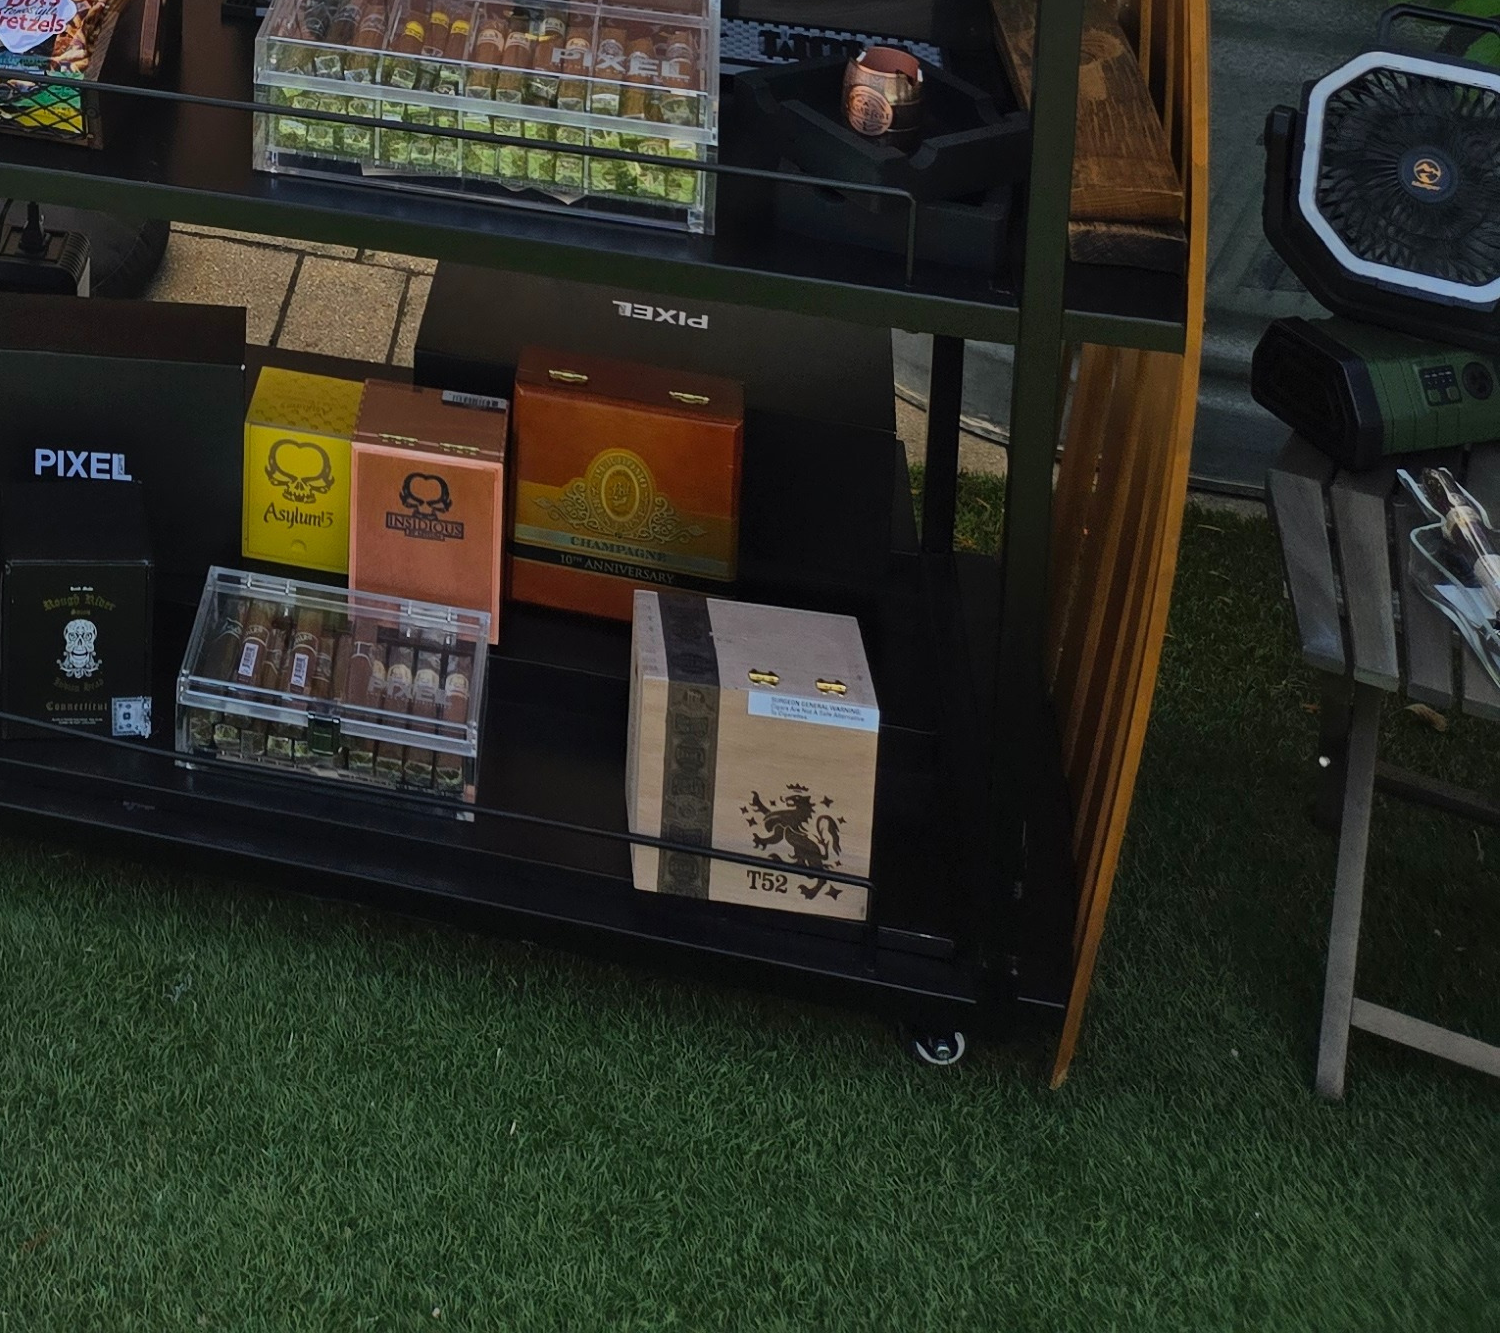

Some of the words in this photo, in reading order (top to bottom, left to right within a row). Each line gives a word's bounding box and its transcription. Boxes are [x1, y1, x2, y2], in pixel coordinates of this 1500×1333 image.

[551, 47, 690, 80] PIXEL
[612, 300, 709, 330] PIXEL
[35, 448, 133, 481] PIXEL
[389, 513, 464, 539] INSIDIOUS
[570, 536, 667, 563] CHAMPAGNE
[584, 558, 675, 584] ANNIVERSARY
[42, 594, 80, 612] Rough
[45, 701, 108, 712] Connecticut
[771, 696, 800, 707] SURGEON
[801, 699, 828, 711] GENERAL
[746, 870, 788, 894] T52
